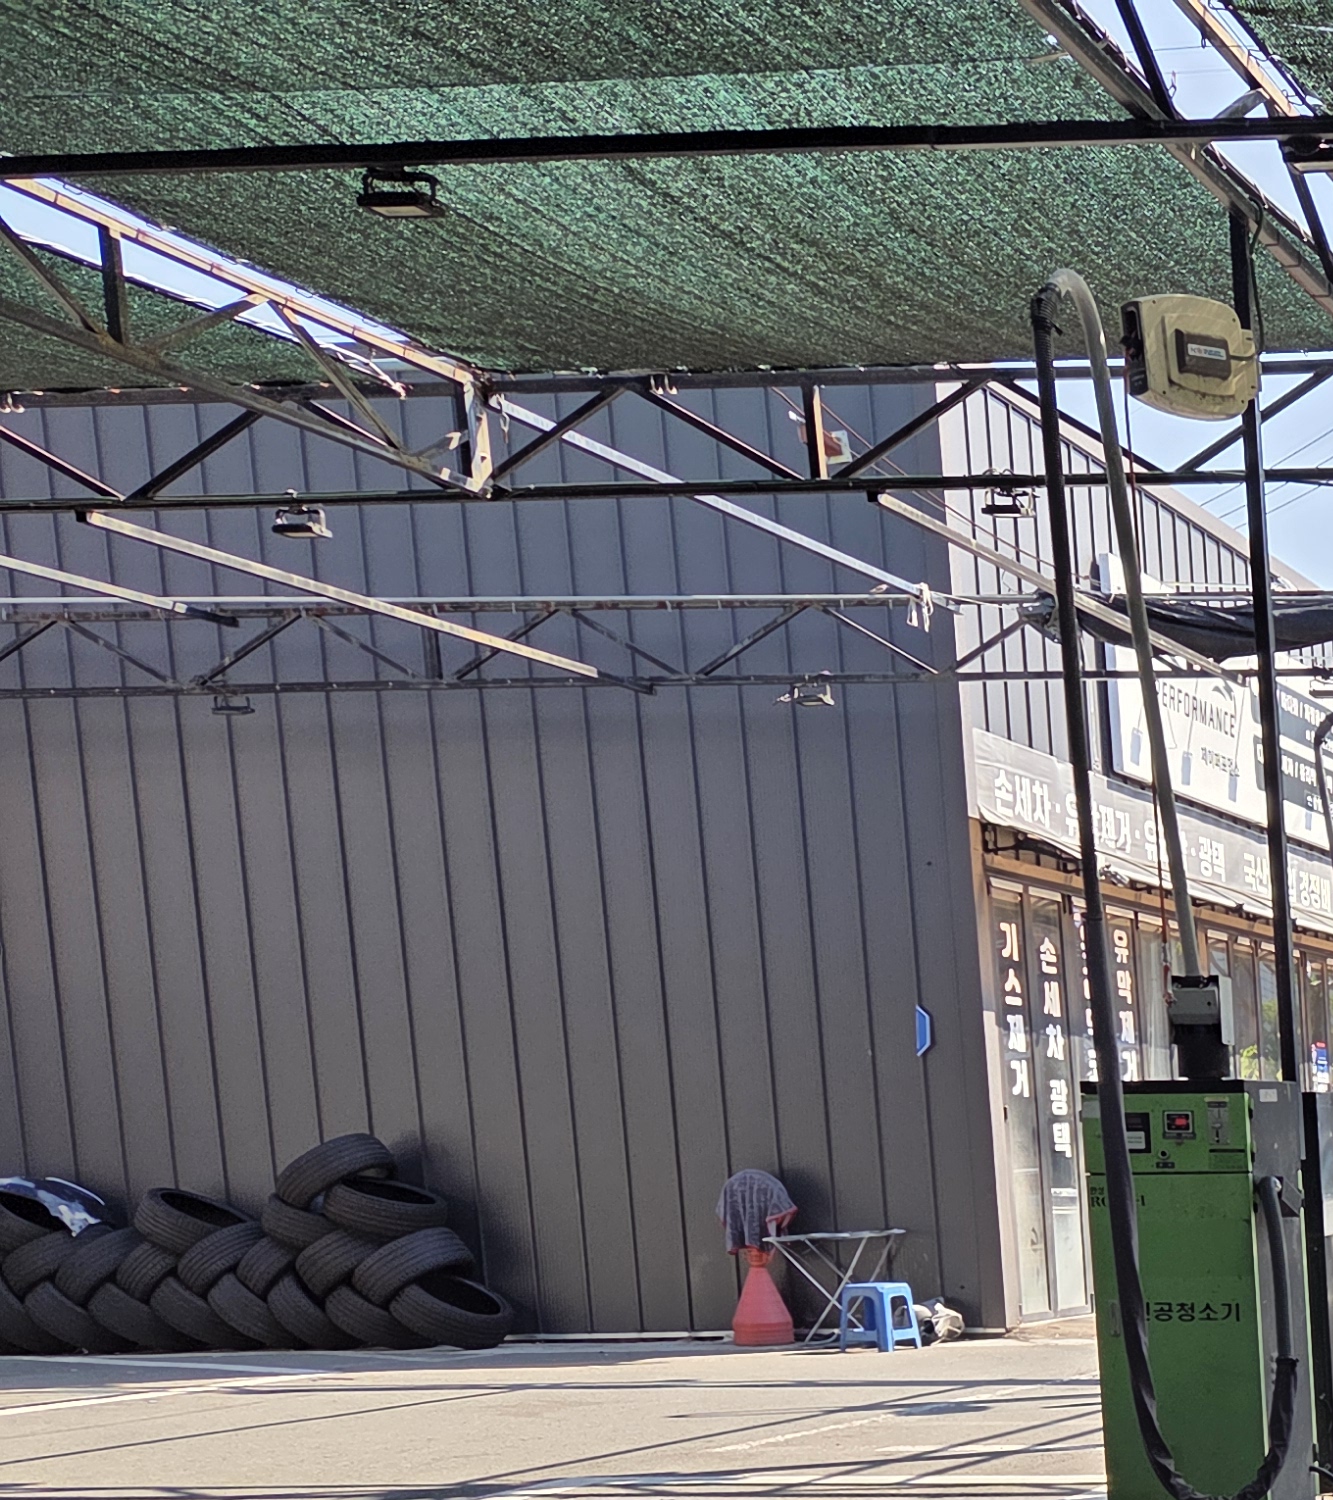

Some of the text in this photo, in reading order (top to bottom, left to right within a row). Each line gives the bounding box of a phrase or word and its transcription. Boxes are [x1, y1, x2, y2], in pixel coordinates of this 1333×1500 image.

[994, 769, 1051, 828] 손세차
[1065, 792, 1131, 854] 유제거
[1198, 835, 1226, 883] 광택
[1000, 922, 1030, 1098] 기스제거
[1040, 936, 1073, 1159] 손세차 광택
[1113, 928, 1139, 1083] 유막제거
[1145, 1302, 1241, 1323] 공청소기
